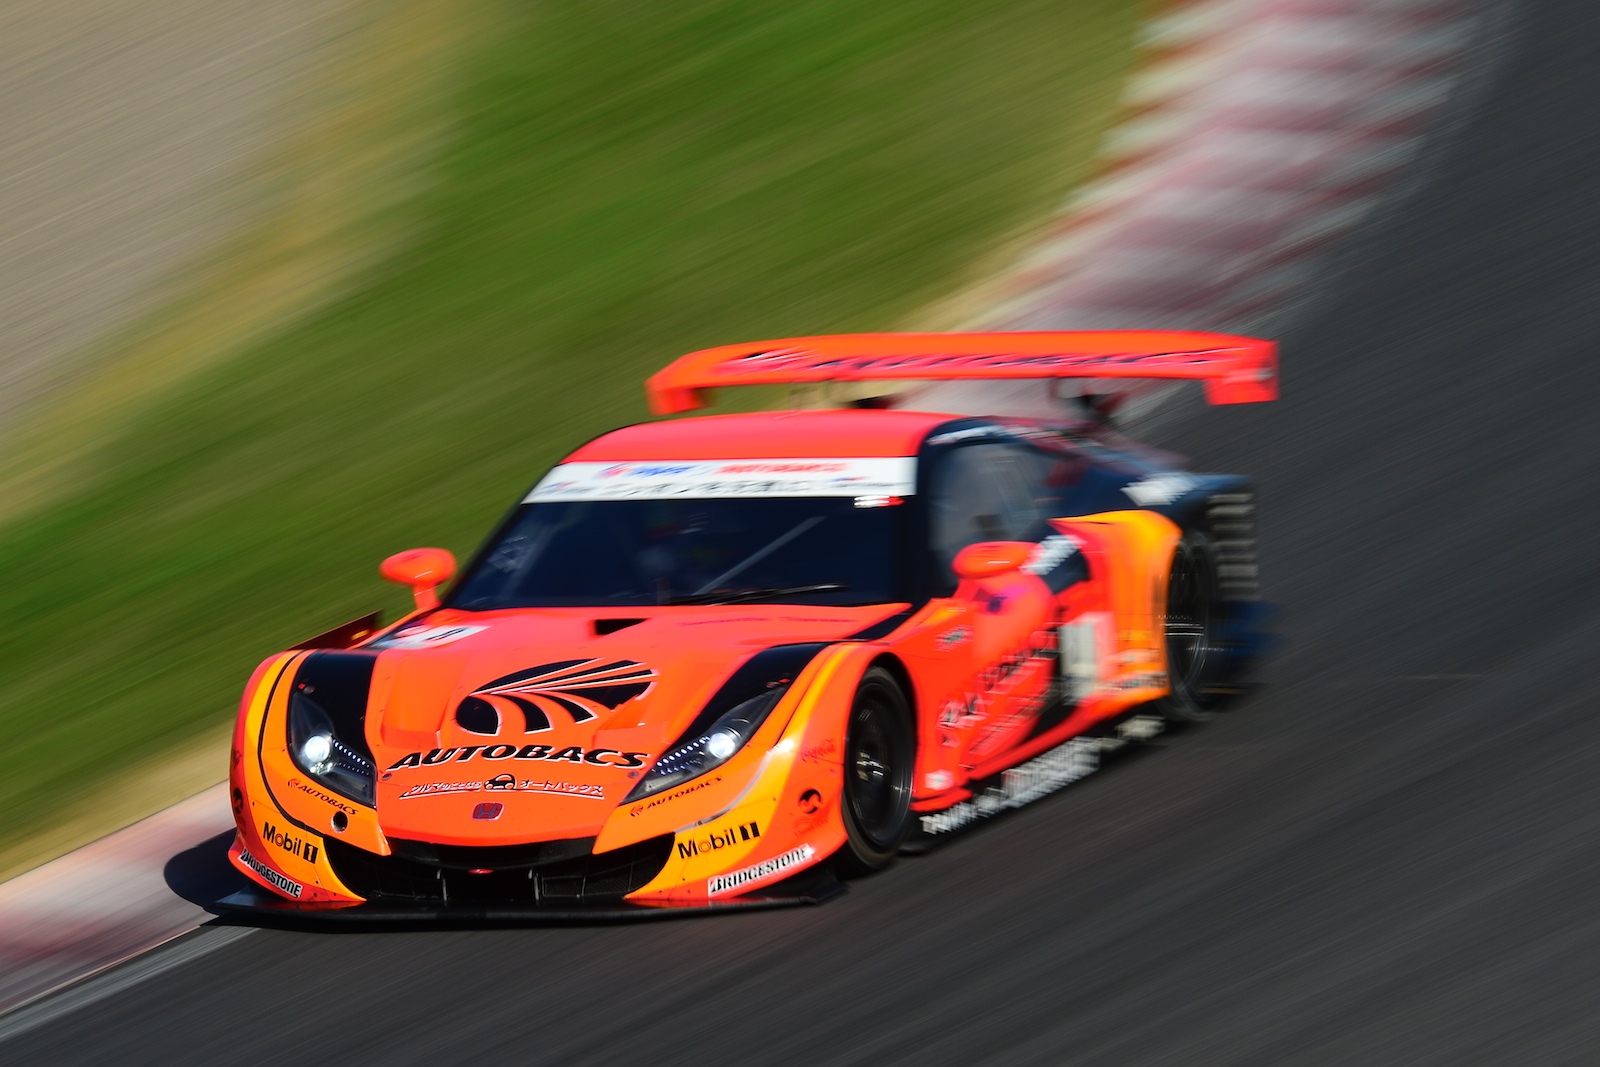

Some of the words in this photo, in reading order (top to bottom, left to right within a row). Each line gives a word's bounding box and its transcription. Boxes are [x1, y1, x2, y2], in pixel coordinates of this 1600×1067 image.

[387, 743, 651, 772] AUTOBACS
[299, 783, 359, 816] AUTOBACS
[519, 780, 604, 795] オートバックス
[647, 777, 723, 809] AUTOBACS
[262, 821, 302, 856] Mobil
[677, 828, 736, 859] Mobil
[240, 848, 302, 897] BRIDGESTONE
[710, 848, 810, 893] BRIDGESTONE
